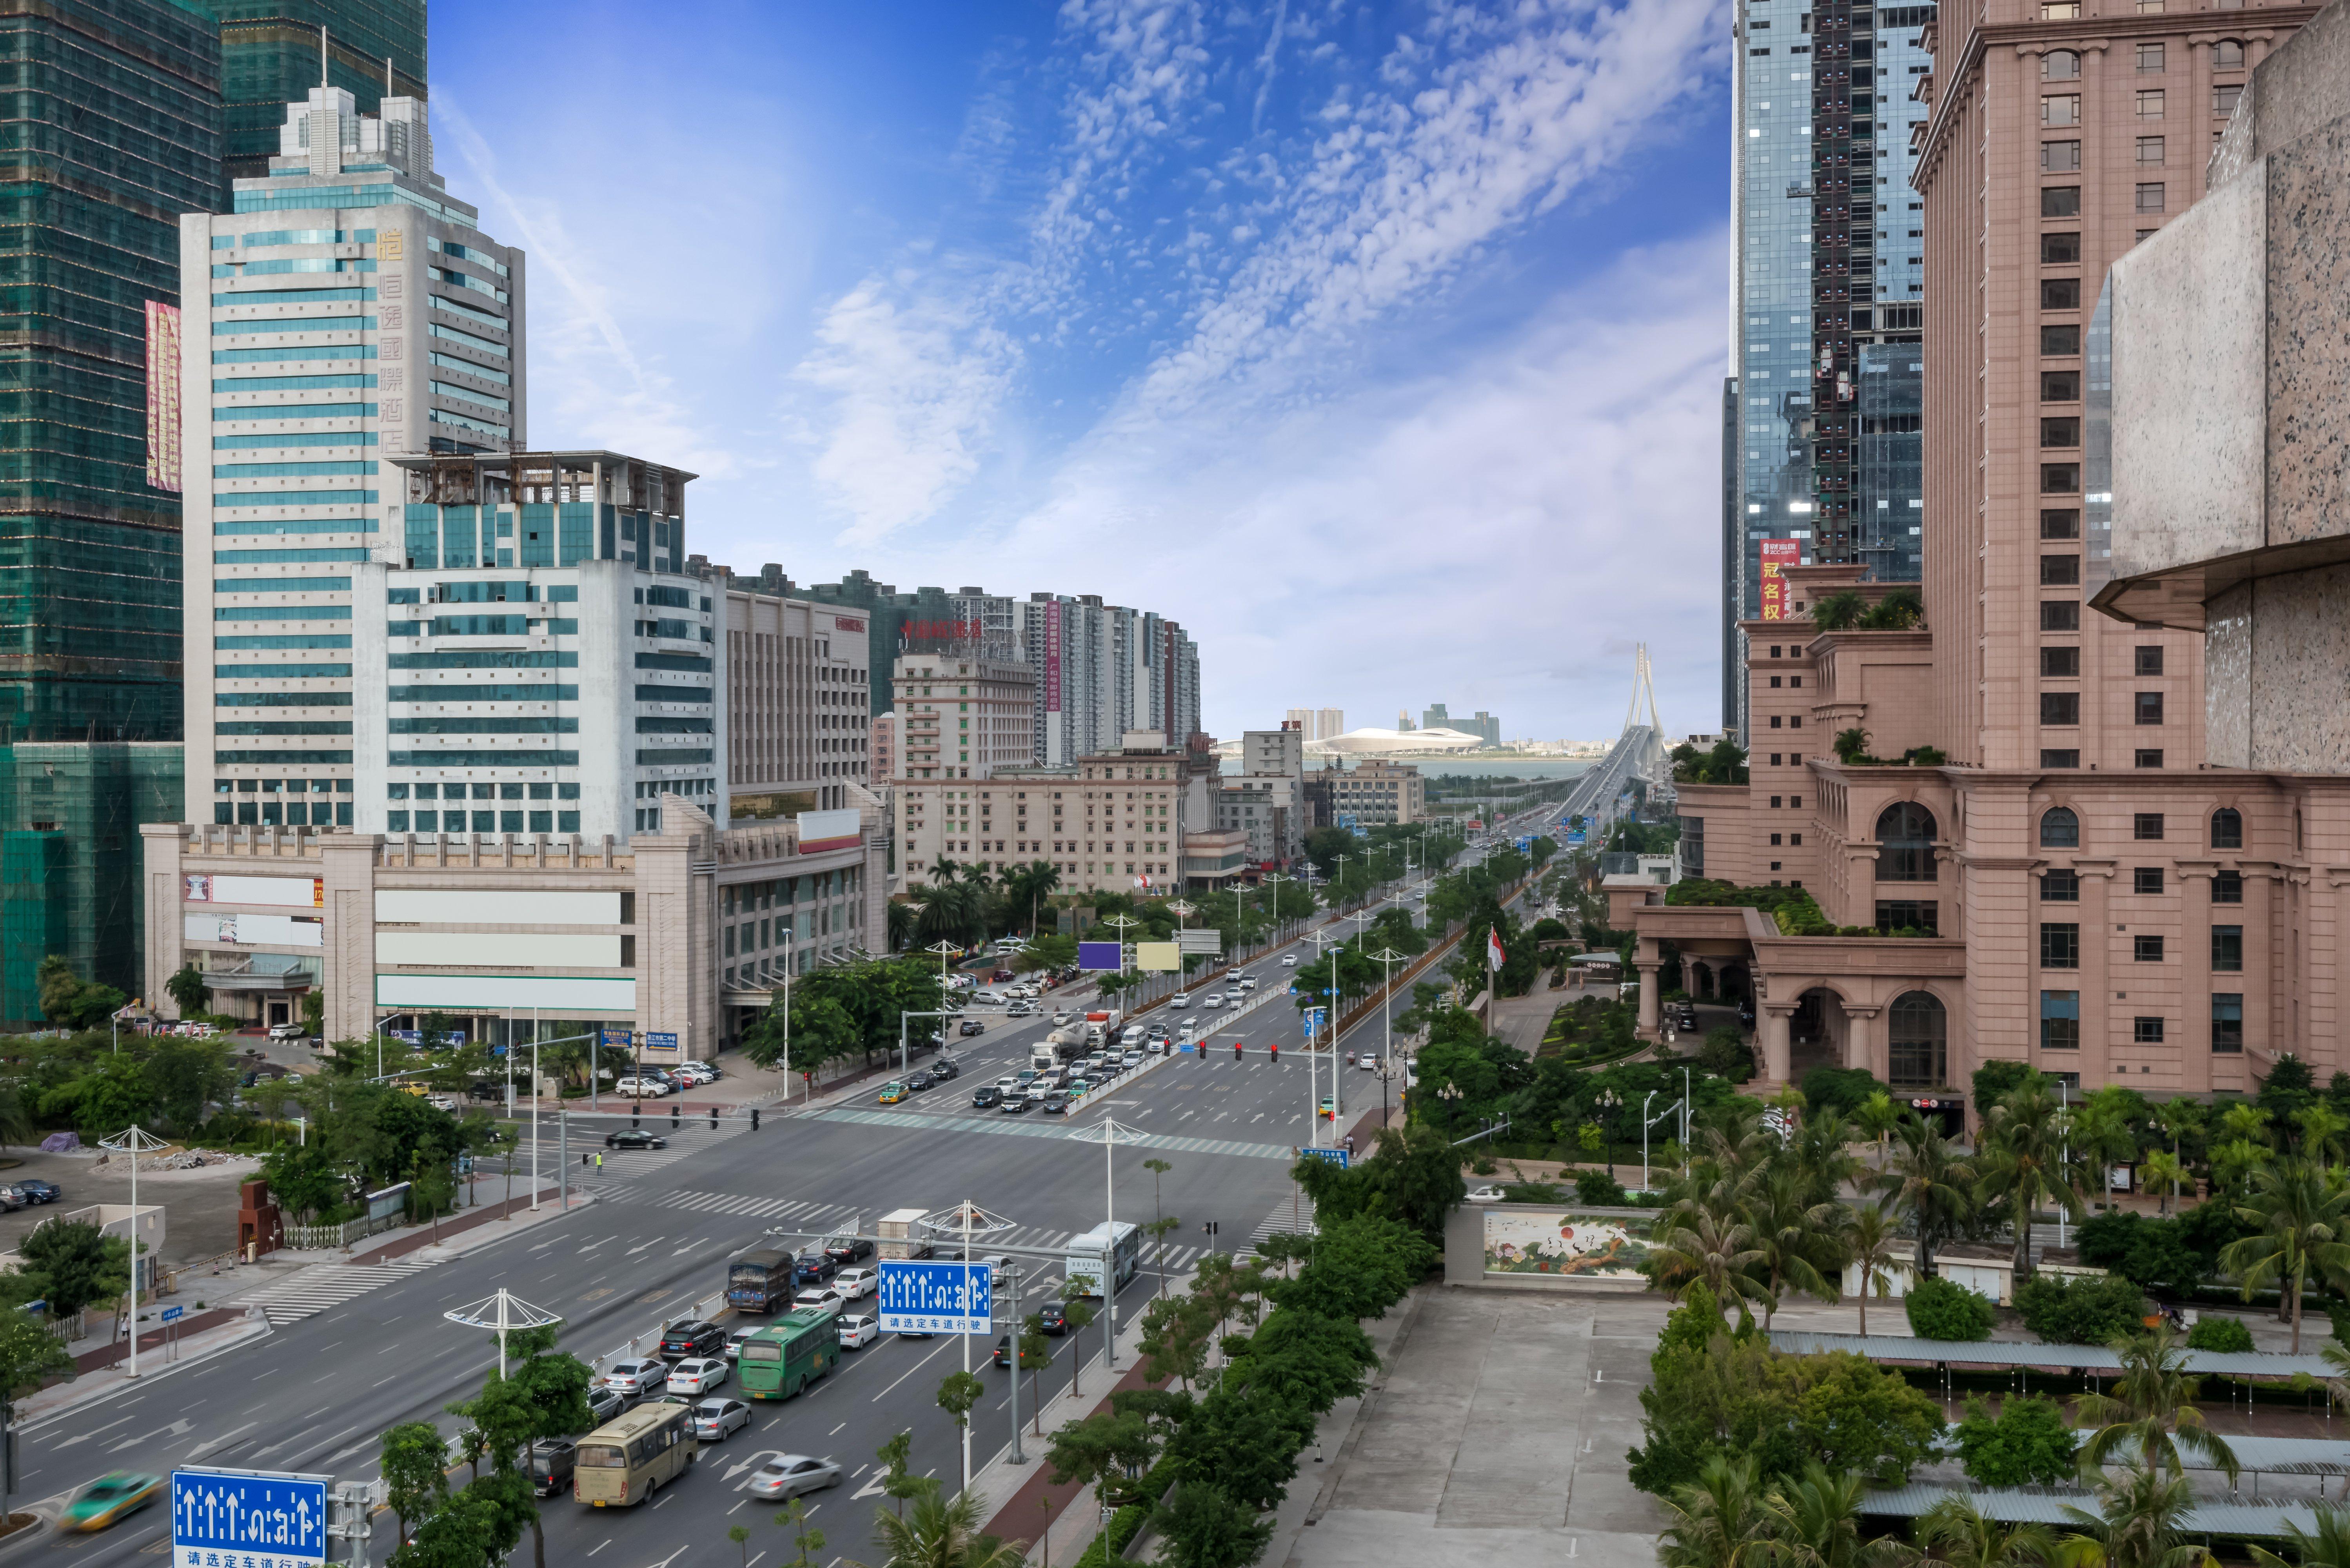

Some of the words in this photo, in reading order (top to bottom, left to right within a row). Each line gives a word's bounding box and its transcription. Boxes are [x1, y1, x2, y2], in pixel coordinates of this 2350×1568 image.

[378, 274, 403, 454] 恒逸國際酒店
[1764, 562, 1780, 621] 冠名权
[1049, 604, 1058, 657] 澳海城游艇体验月
[1050, 664, 1058, 710] 广和号即将启航
[890, 1317, 981, 1330] 请选定车道行驶
